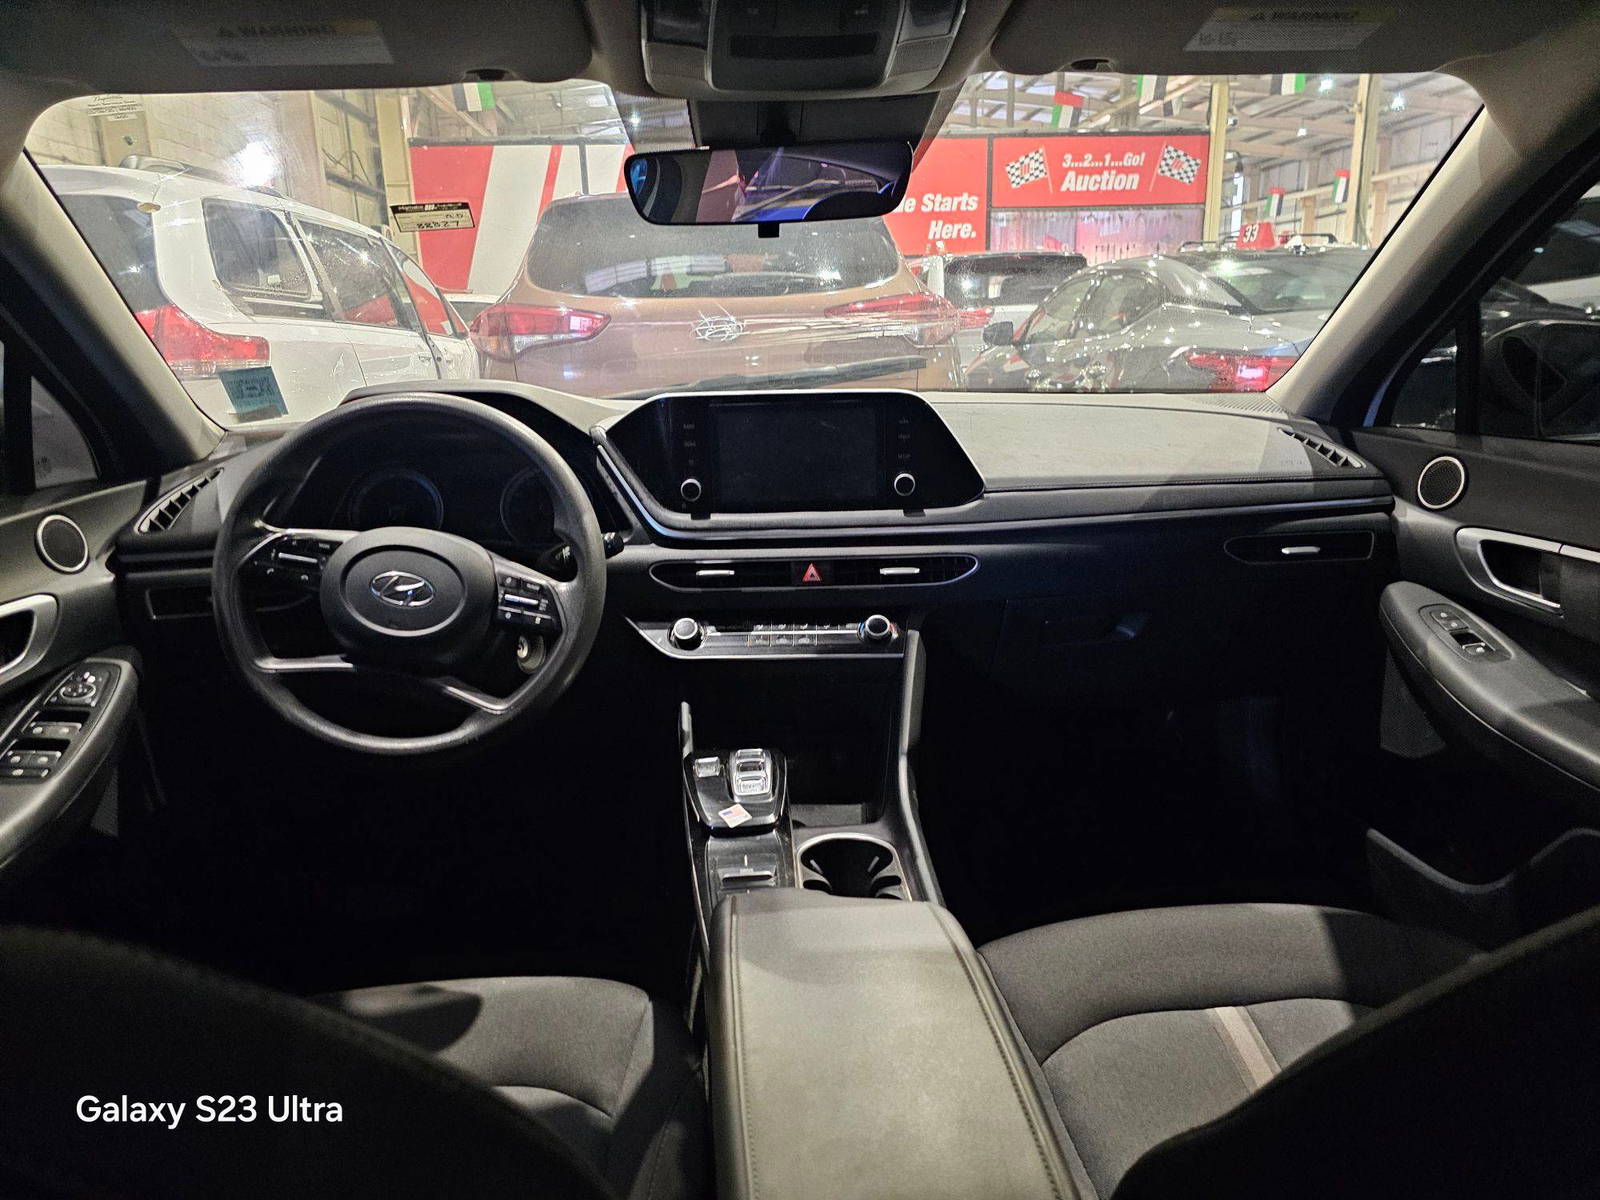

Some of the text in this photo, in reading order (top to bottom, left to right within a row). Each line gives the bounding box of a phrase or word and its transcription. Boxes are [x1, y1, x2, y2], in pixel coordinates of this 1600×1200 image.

[1060, 169, 1140, 192] Auction
[920, 191, 979, 213] Starts
[927, 219, 977, 240] Here.
[1243, 224, 1260, 243] 33
